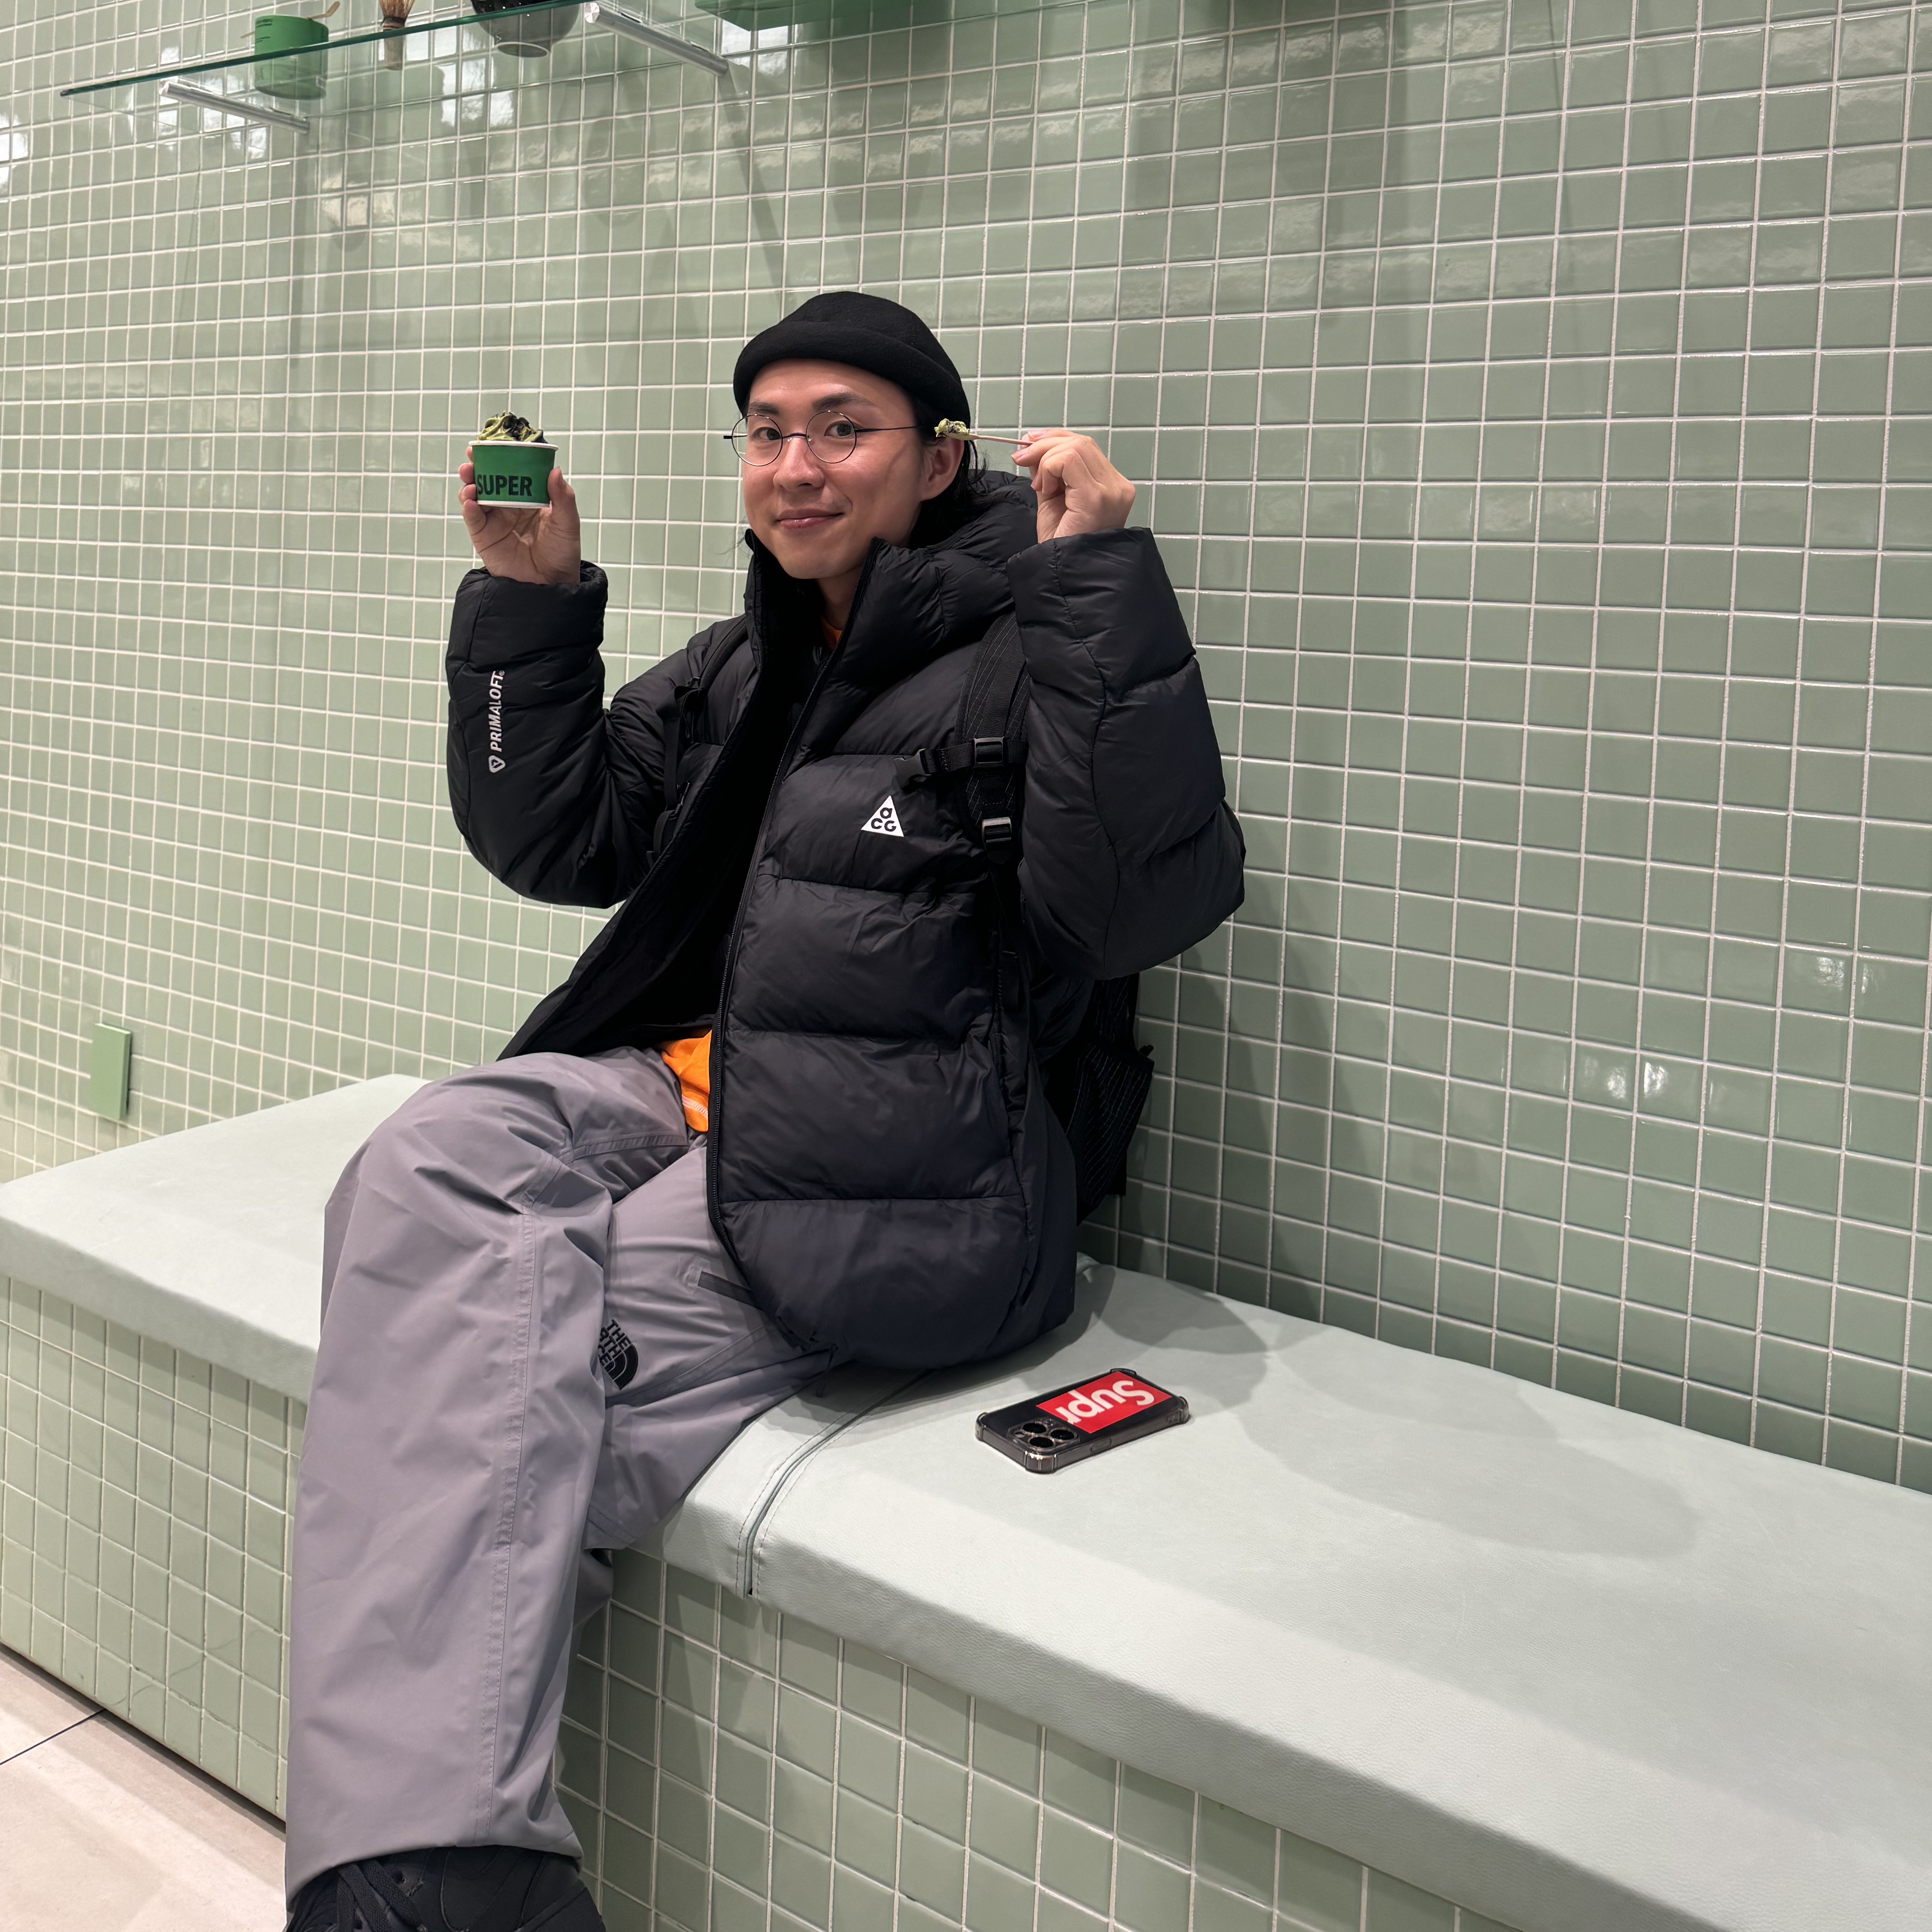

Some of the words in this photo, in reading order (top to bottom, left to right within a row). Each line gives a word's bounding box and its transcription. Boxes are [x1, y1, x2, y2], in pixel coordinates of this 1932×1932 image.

[477, 474, 532, 496] SUPER
[599, 1327, 622, 1358] RTH
[607, 1319, 632, 1350] THE
